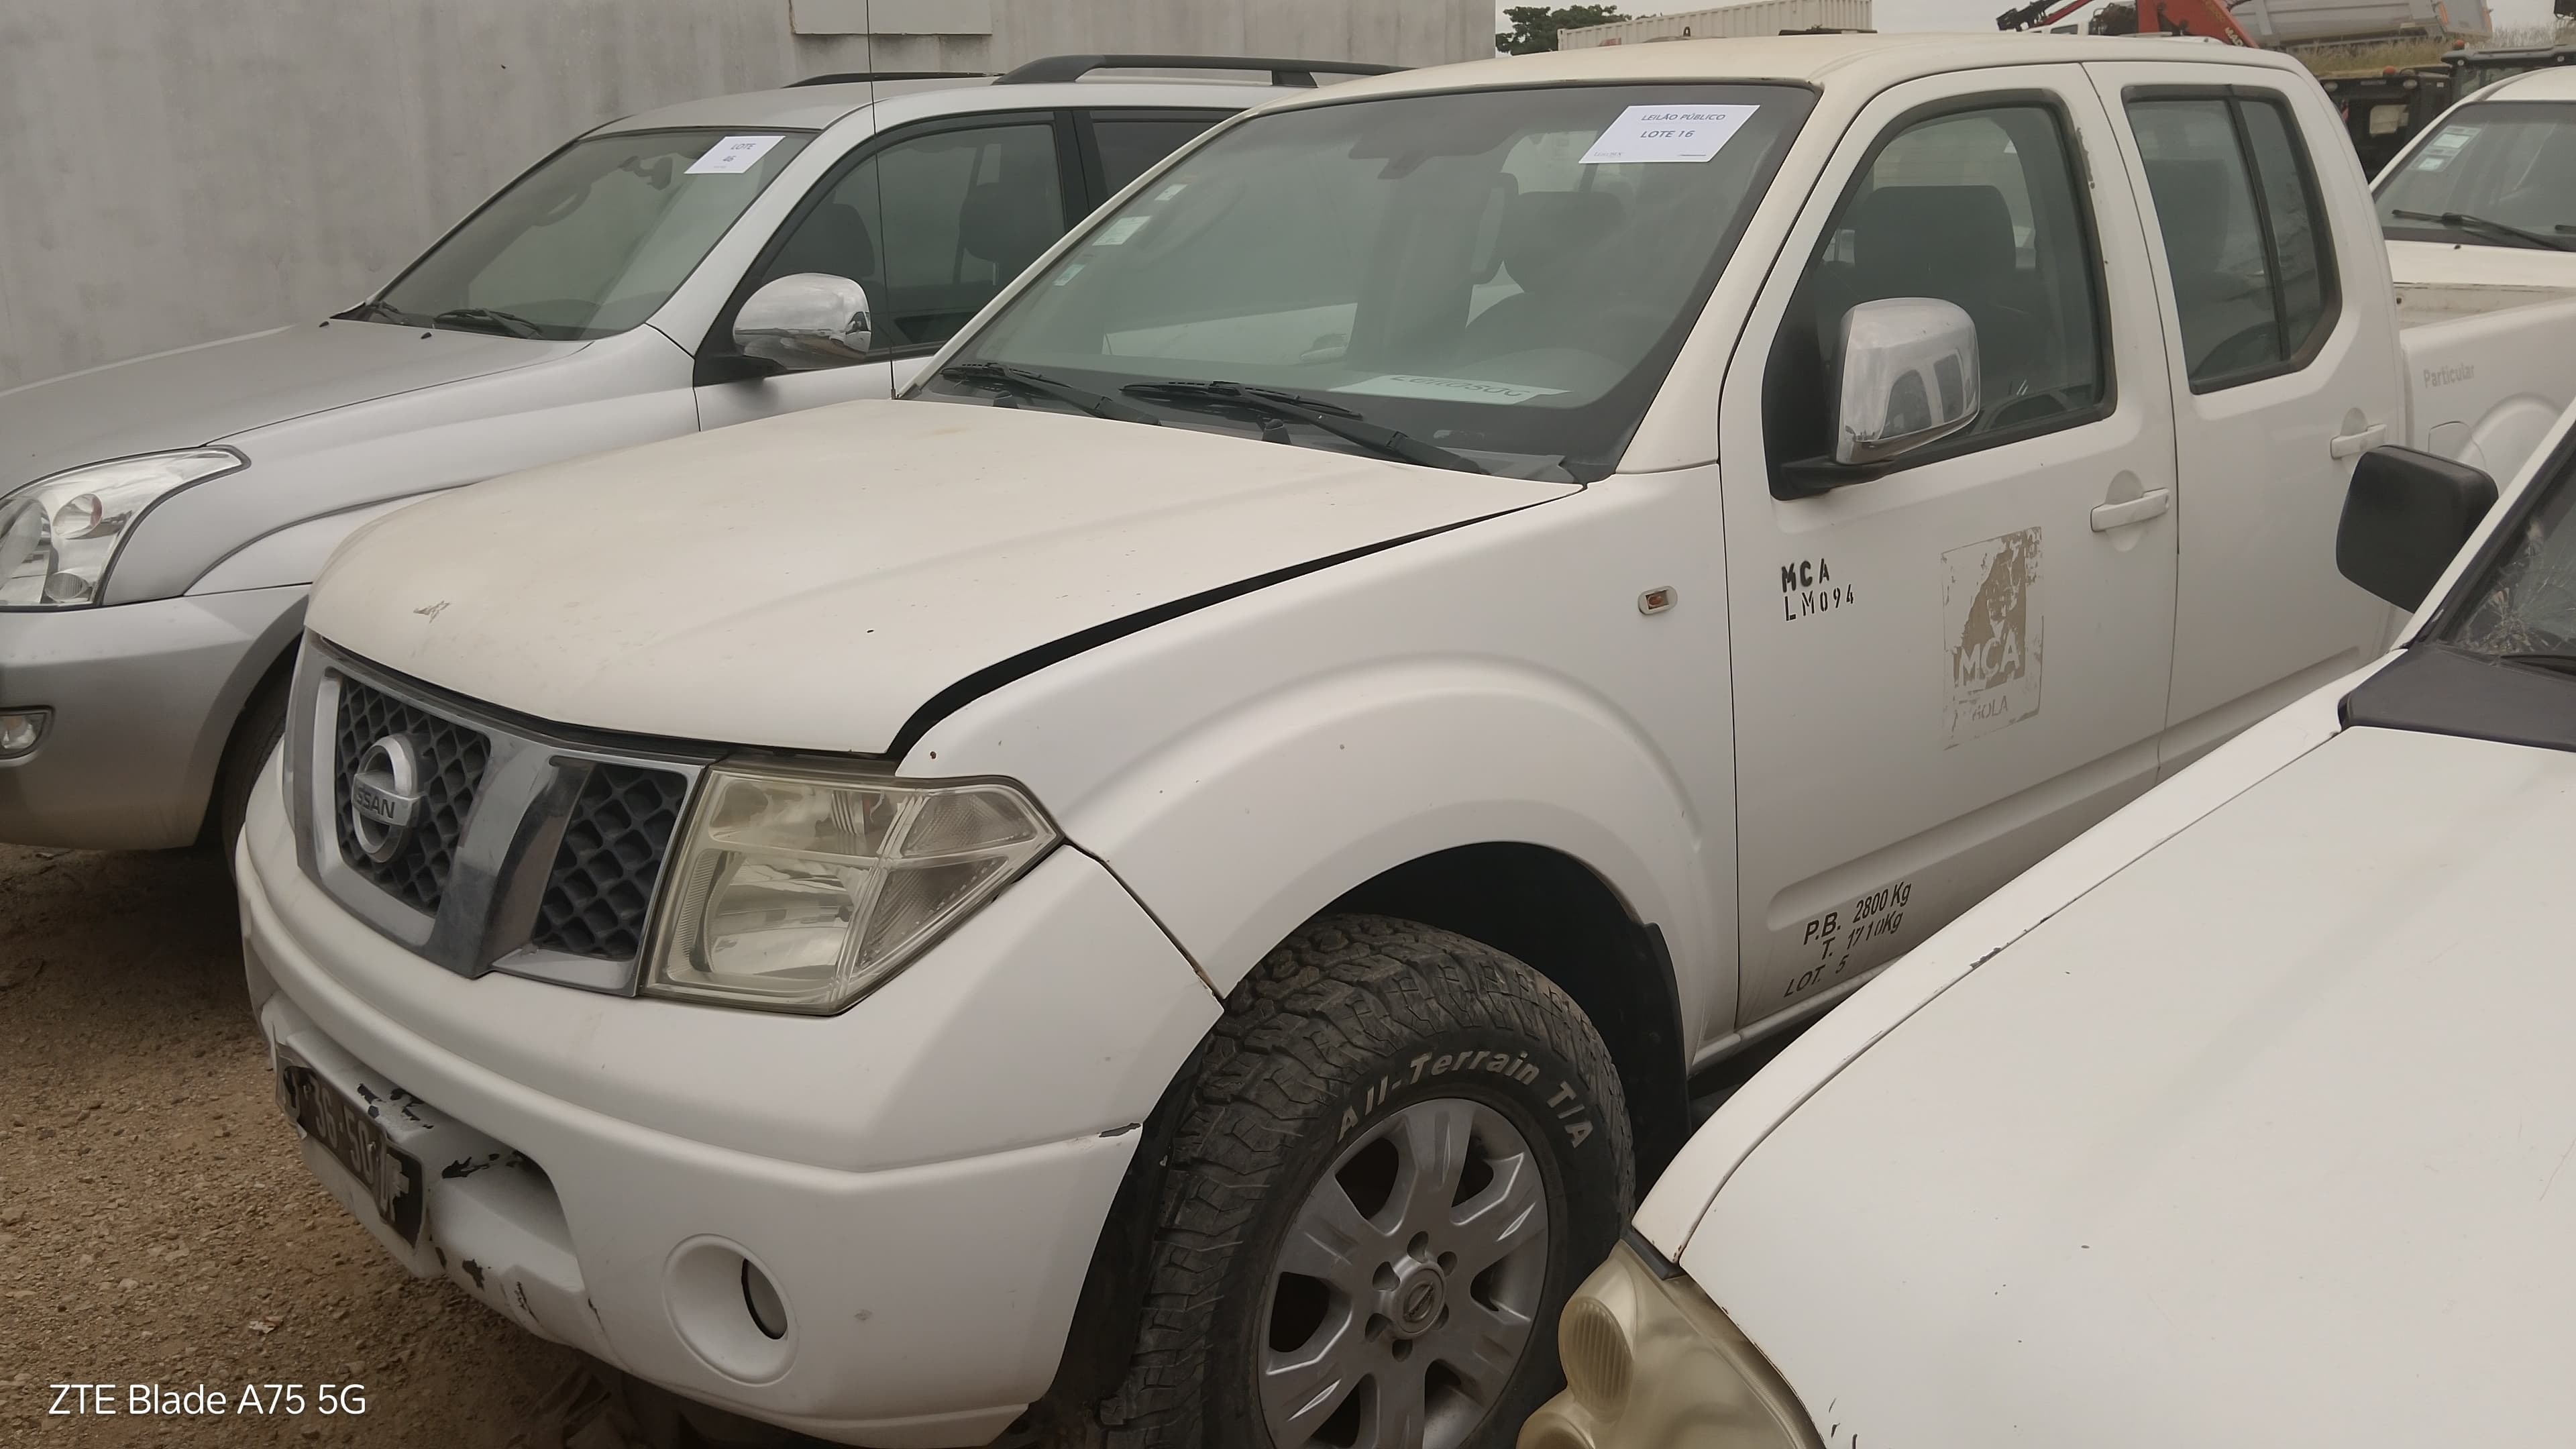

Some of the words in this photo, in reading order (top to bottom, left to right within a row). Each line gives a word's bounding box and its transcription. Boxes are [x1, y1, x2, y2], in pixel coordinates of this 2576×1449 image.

[1640, 130, 1676, 138] LOTE
[1641, 112, 1678, 121] LEILÃO
[1679, 111, 1727, 121] PÚBLICO
[2423, 361, 2475, 388] Particular
[1781, 557, 1830, 593] MCA
[1784, 584, 1855, 622] LM094
[1958, 629, 2021, 688] MCA
[1803, 911, 1841, 946] P.B.
[1852, 888, 1889, 924] 2800
[1890, 881, 1911, 908] Kg
[1821, 936, 1835, 961] T.
[1783, 964, 1826, 998] LOT.
[1835, 954, 1849, 975] 5
[1336, 1050, 1540, 1143] All-Terrain
[1547, 1082, 1595, 1149] T/A
